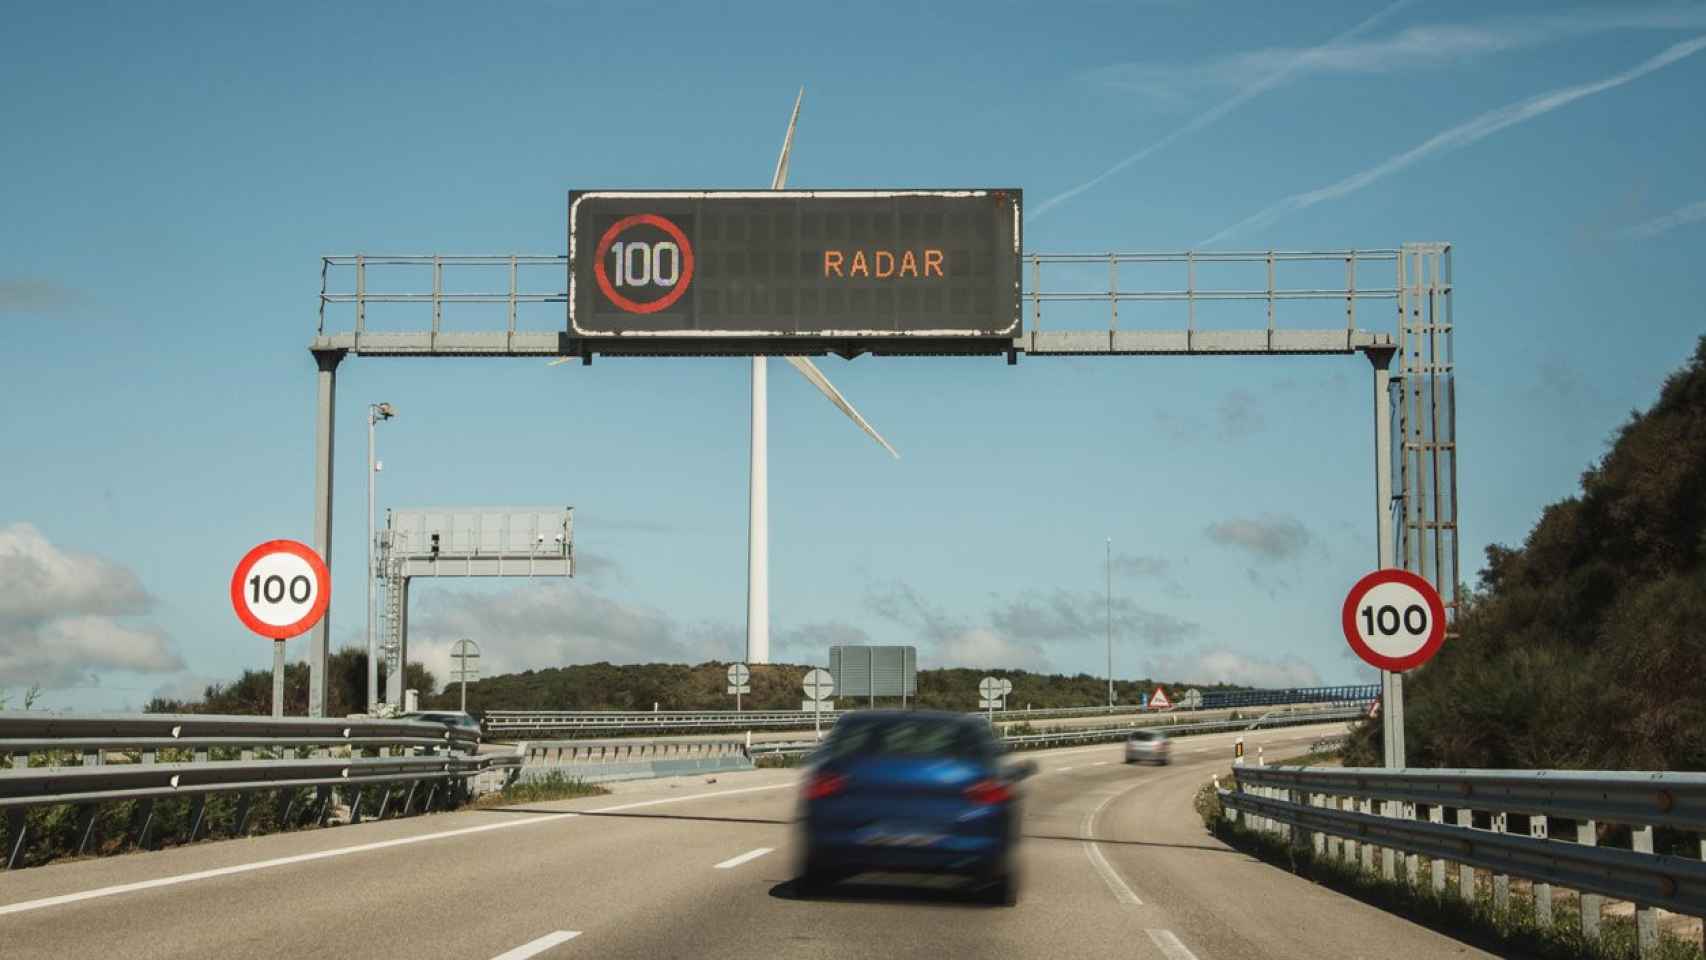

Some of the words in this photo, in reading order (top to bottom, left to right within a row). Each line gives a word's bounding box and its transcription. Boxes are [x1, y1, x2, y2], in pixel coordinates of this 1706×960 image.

[611, 241, 679, 287] 100
[825, 249, 945, 279] RADAR
[250, 574, 311, 604] 100
[1361, 604, 1427, 636] 100
